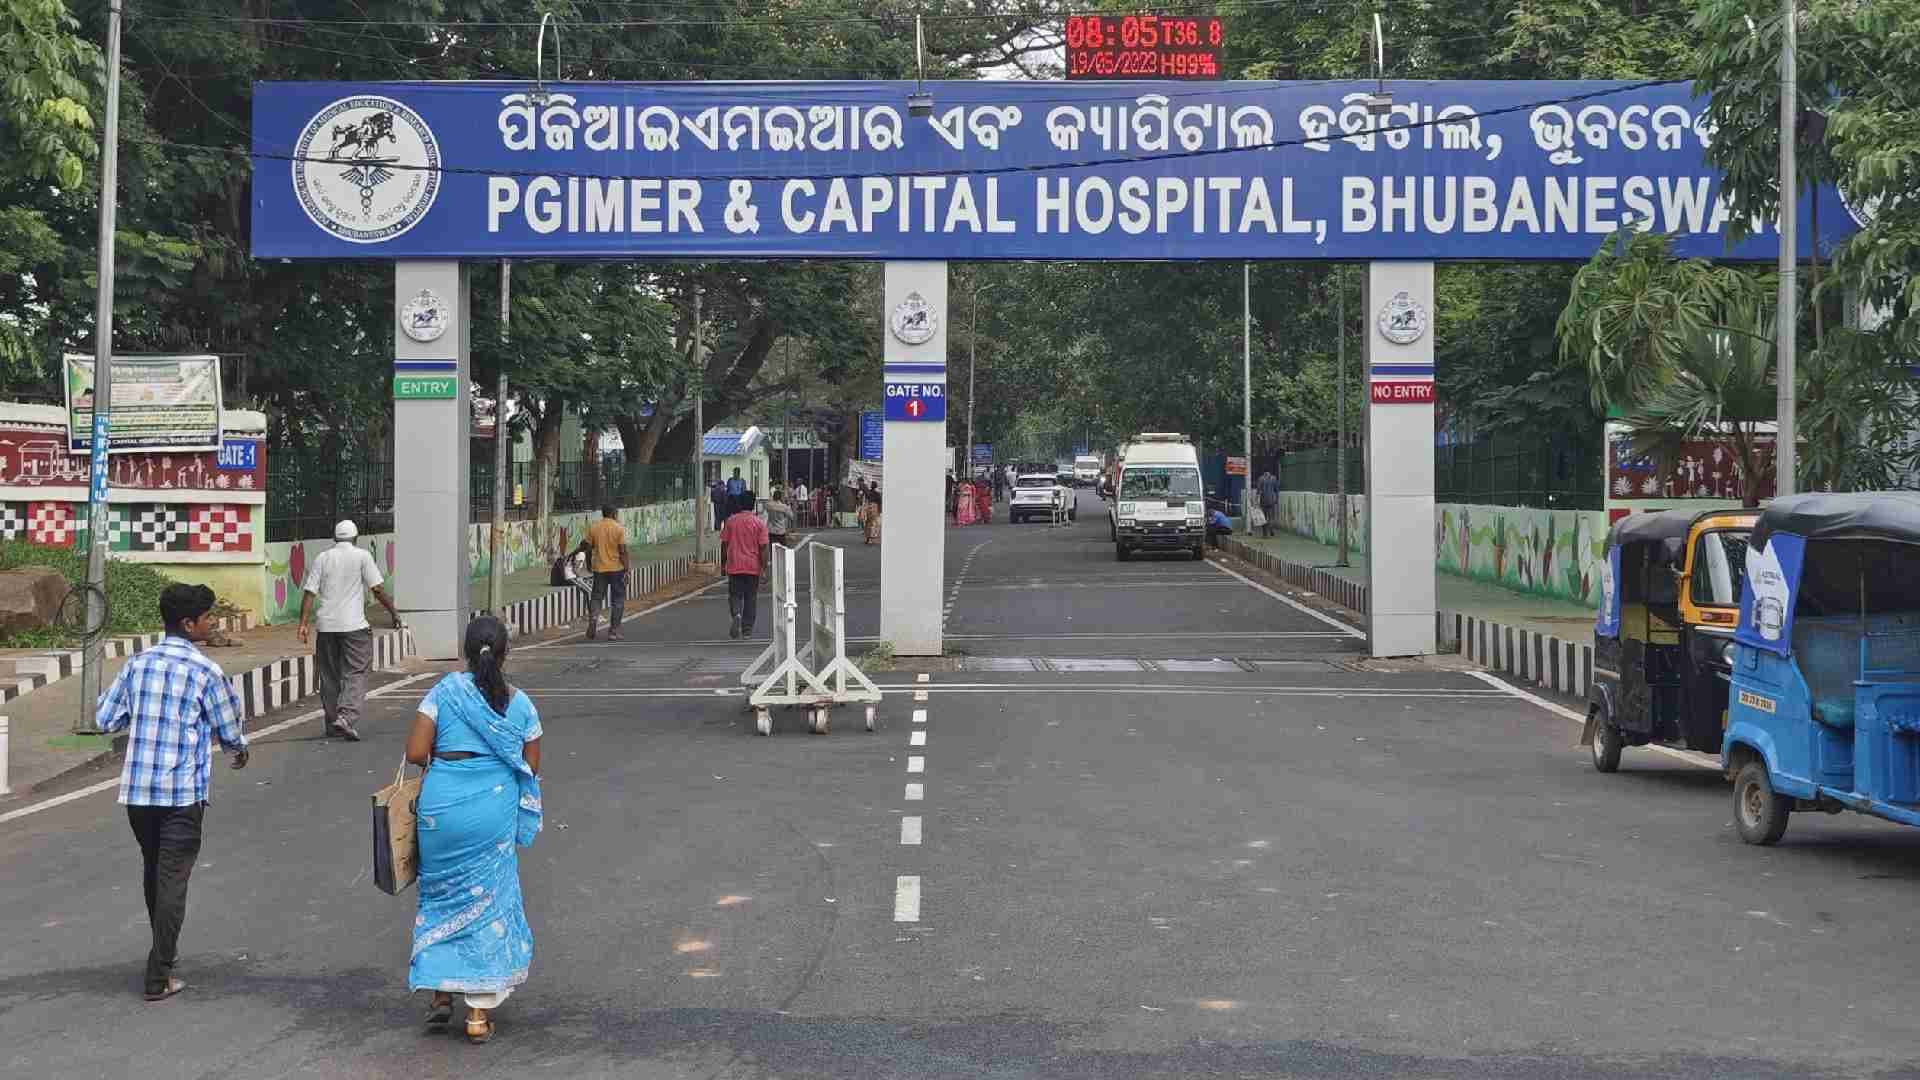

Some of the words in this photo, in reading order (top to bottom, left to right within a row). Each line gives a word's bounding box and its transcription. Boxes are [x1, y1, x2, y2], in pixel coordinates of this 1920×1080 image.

[1067, 16, 1158, 48] 08:05
[1161, 21, 1221, 46] T36.8
[929, 103, 1022, 151] ଏବଂ
[488, 176, 702, 234] PGIMER
[725, 176, 761, 235] &
[781, 176, 1016, 235] CAPITAL
[1037, 176, 1327, 244] HOSPITAL,
[1342, 175, 1781, 235] BHUBANESWA
[401, 381, 449, 394] ENTRY
[886, 384, 919, 398] GATE
[922, 384, 944, 398] NO.
[1374, 385, 1391, 398] NO
[1394, 385, 1432, 398] ENTRY
[909, 400, 918, 417] 1
[218, 444, 244, 466] GATE
